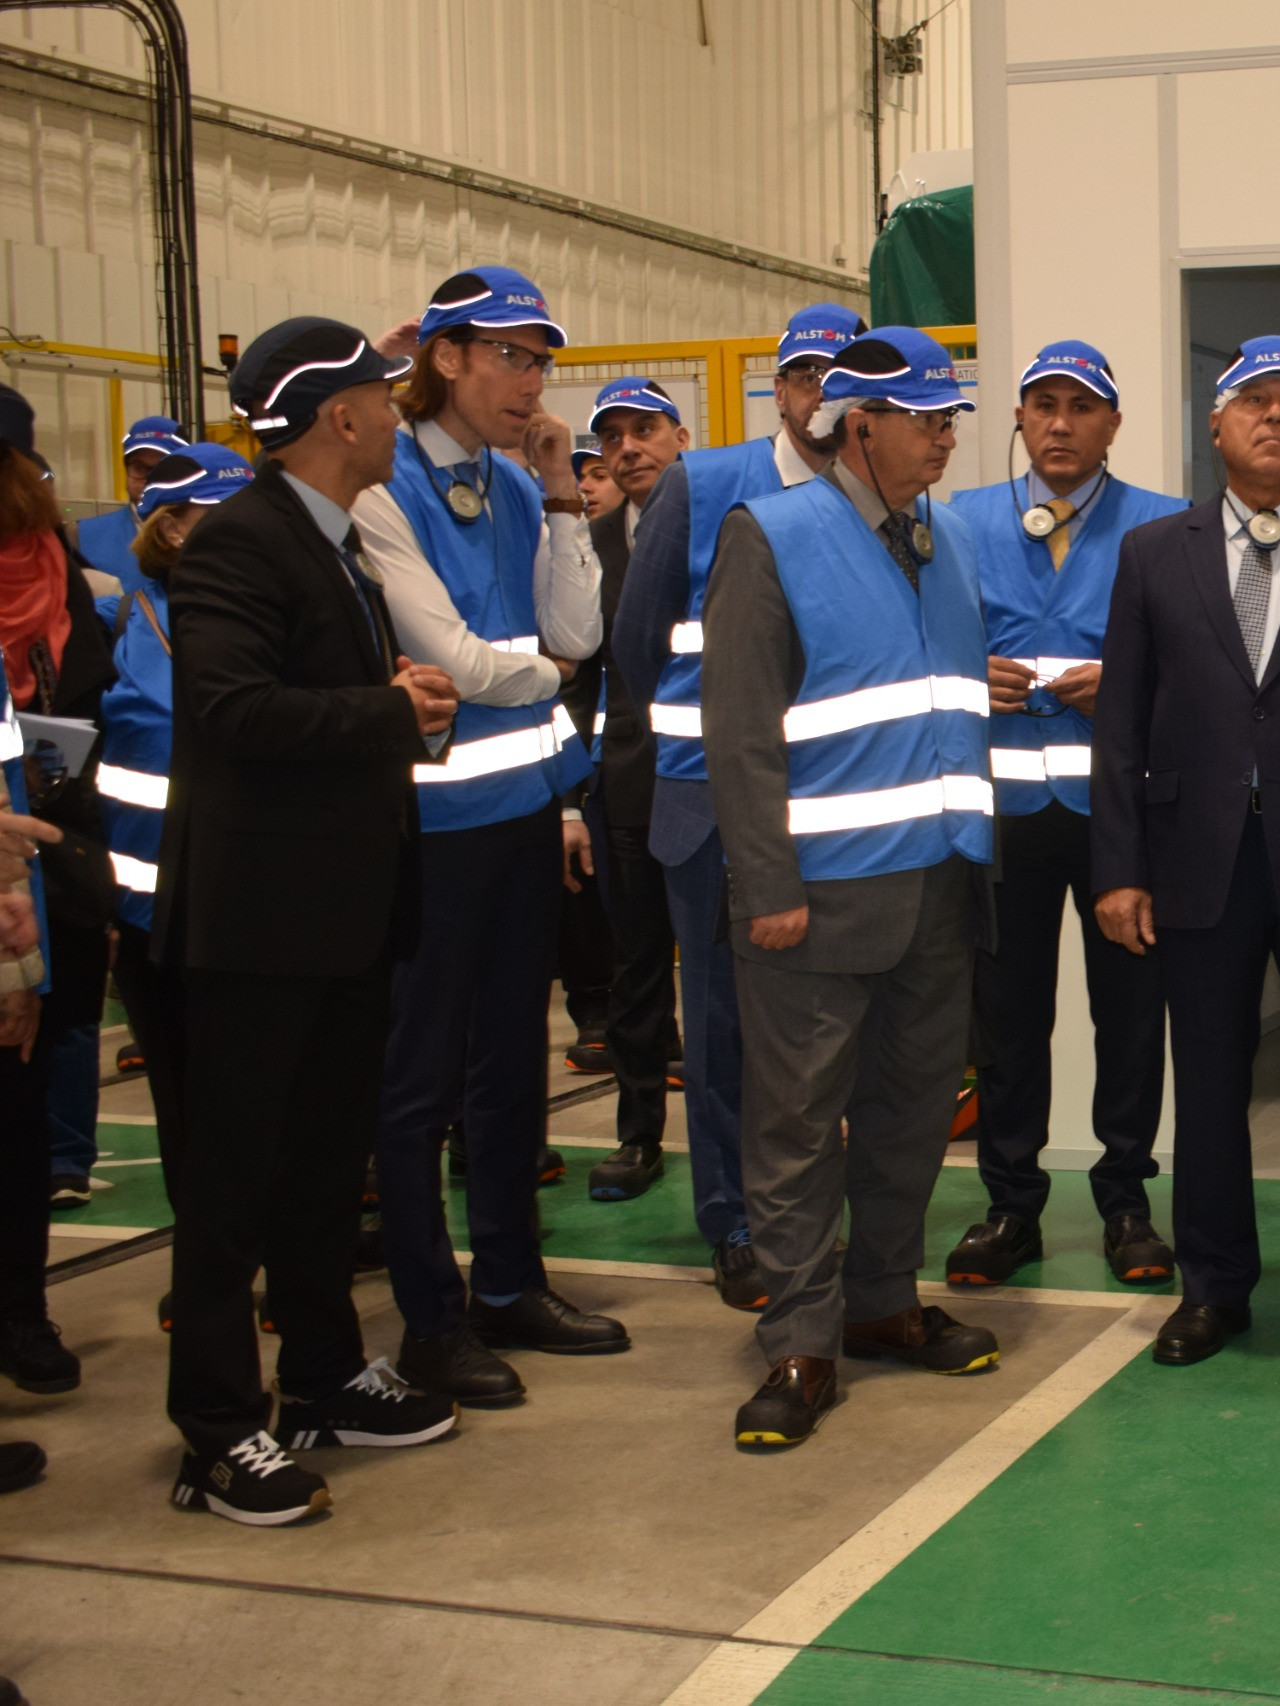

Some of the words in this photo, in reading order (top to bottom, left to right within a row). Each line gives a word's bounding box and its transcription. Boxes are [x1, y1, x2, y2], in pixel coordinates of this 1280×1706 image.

[794, 329, 846, 343] ALSTOM
[1047, 356, 1096, 373] ALSTOM
[925, 367, 955, 380] ALSTO
[218, 467, 255, 479] ALSTO
